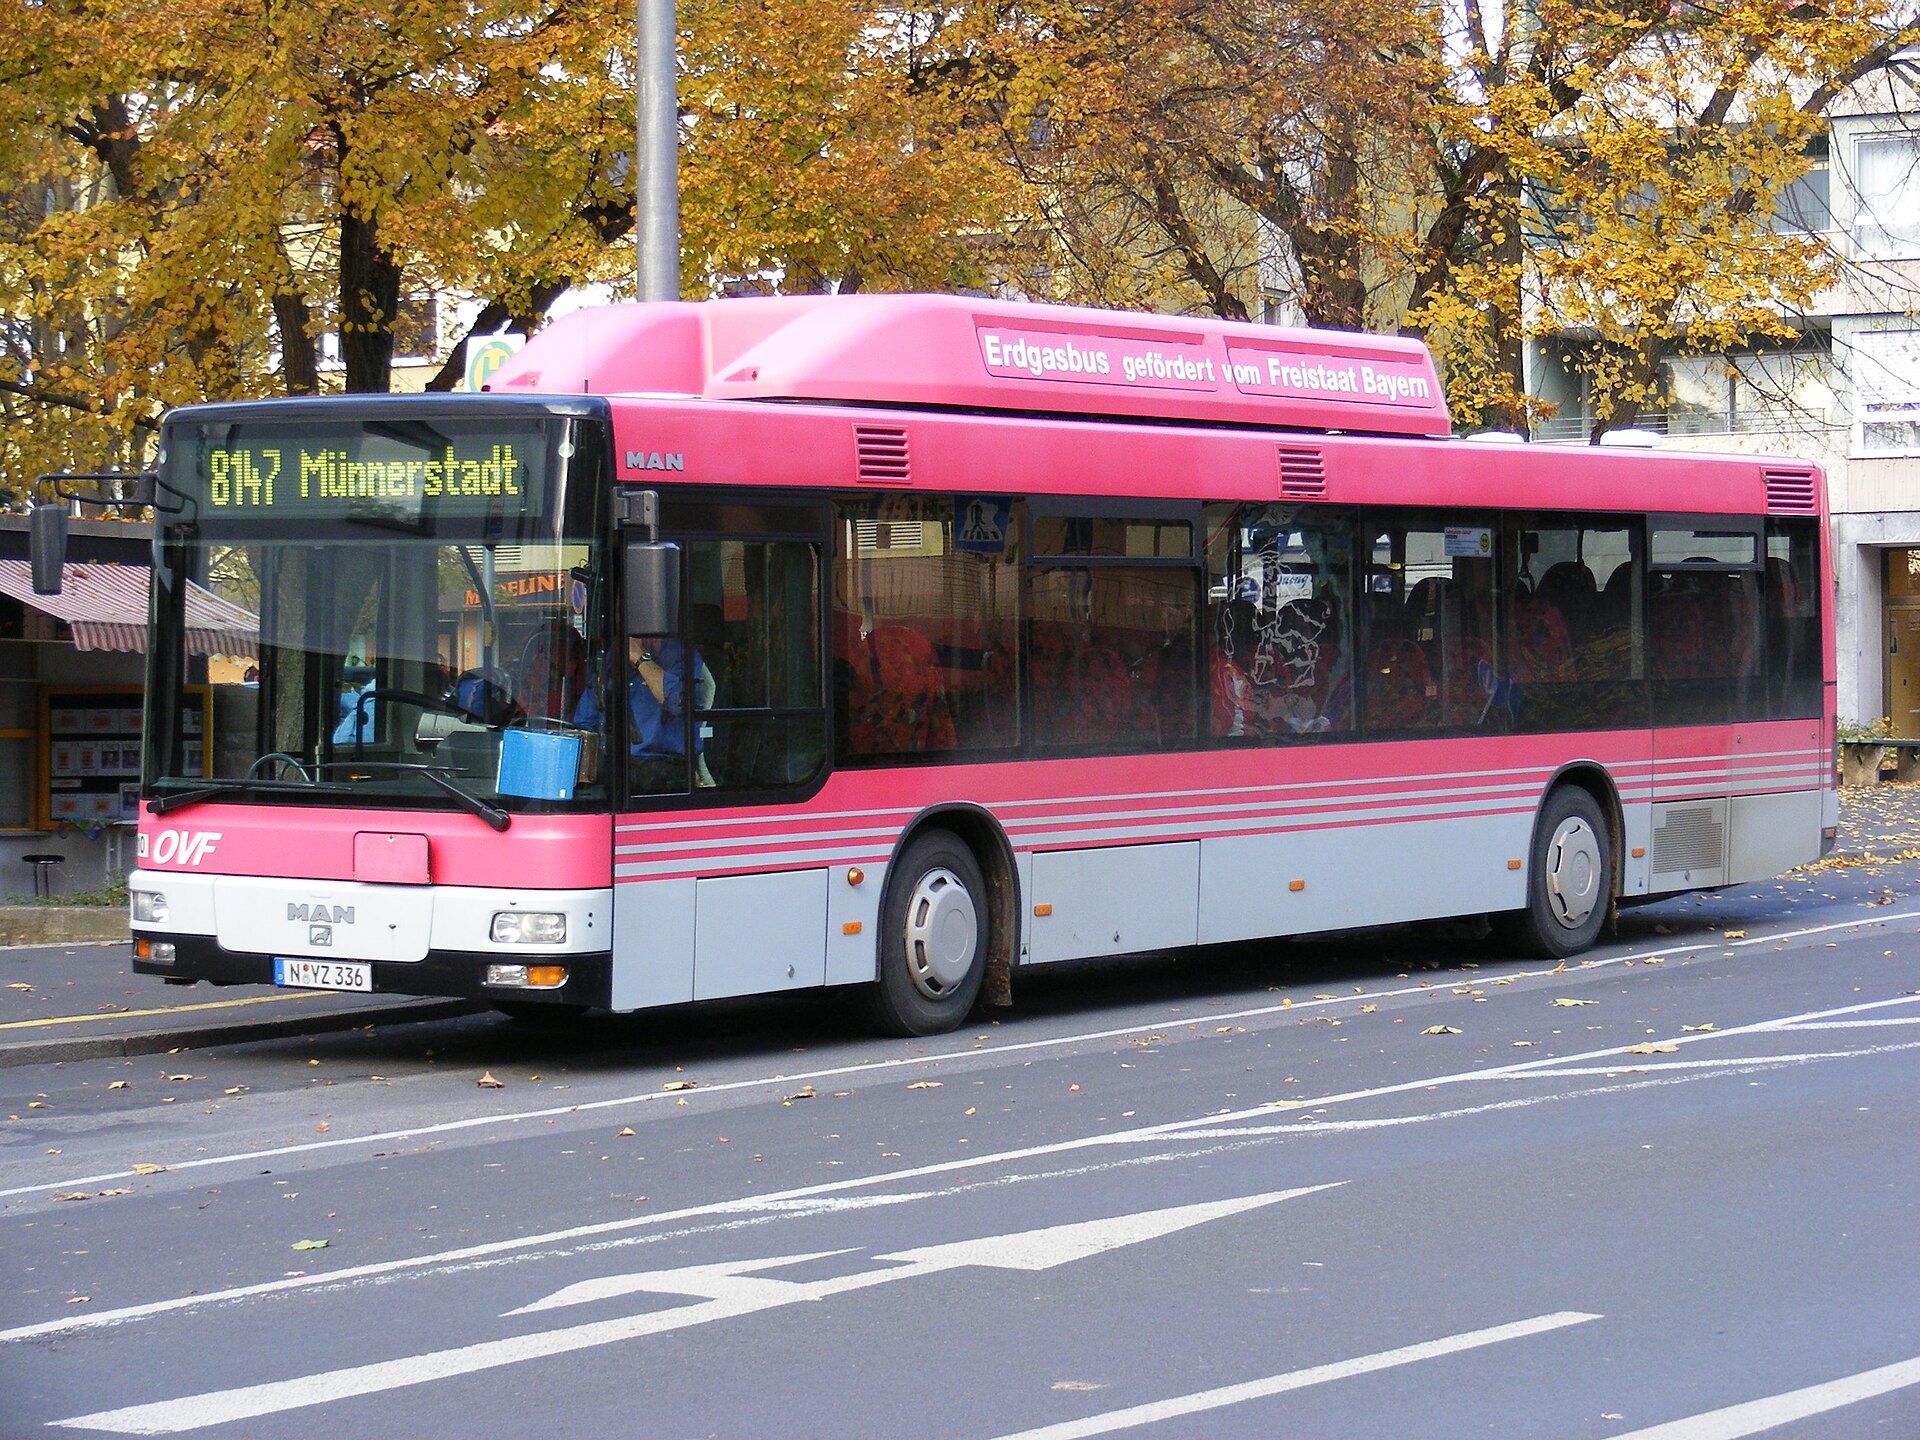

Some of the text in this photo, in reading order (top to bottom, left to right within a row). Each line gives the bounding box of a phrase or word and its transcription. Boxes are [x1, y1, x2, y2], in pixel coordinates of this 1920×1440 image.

[984, 335, 1429, 401] Erdgasbus gefördert vom Freistaat Bayern
[210, 444, 519, 506] 8147 Münnerstadt
[625, 451, 684, 471] MAN
[465, 573, 564, 606] MELINE
[152, 829, 223, 866] OVF
[287, 903, 355, 924] MAN
[290, 963, 363, 987] N YZ 336
